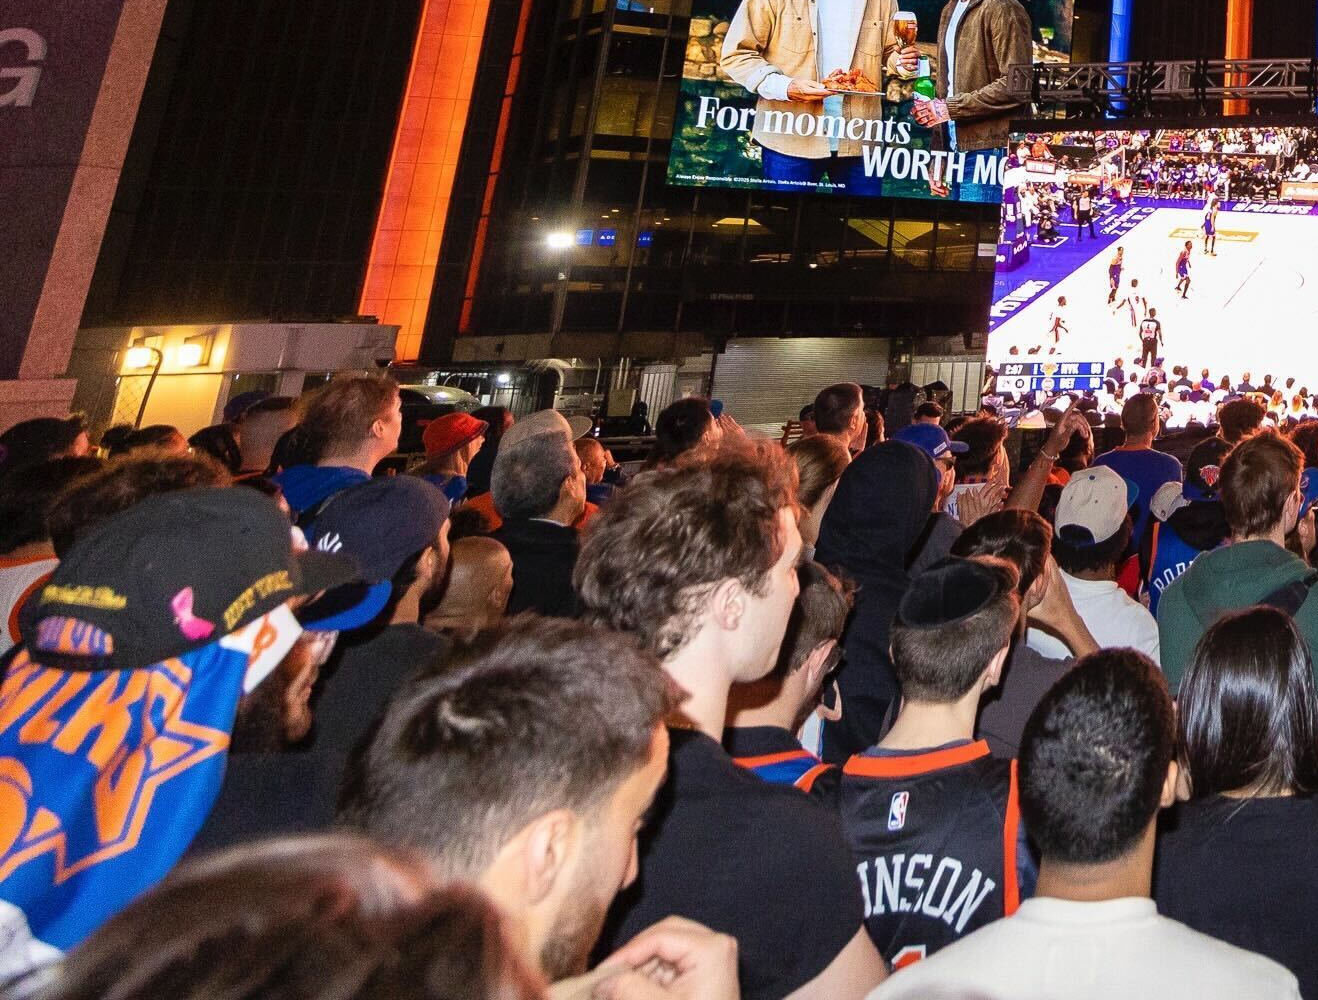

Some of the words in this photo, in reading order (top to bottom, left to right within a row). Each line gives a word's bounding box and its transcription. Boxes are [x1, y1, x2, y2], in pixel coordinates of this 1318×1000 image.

[696, 95, 757, 131] For
[763, 109, 912, 146] moments
[863, 144, 966, 182] WORTH
